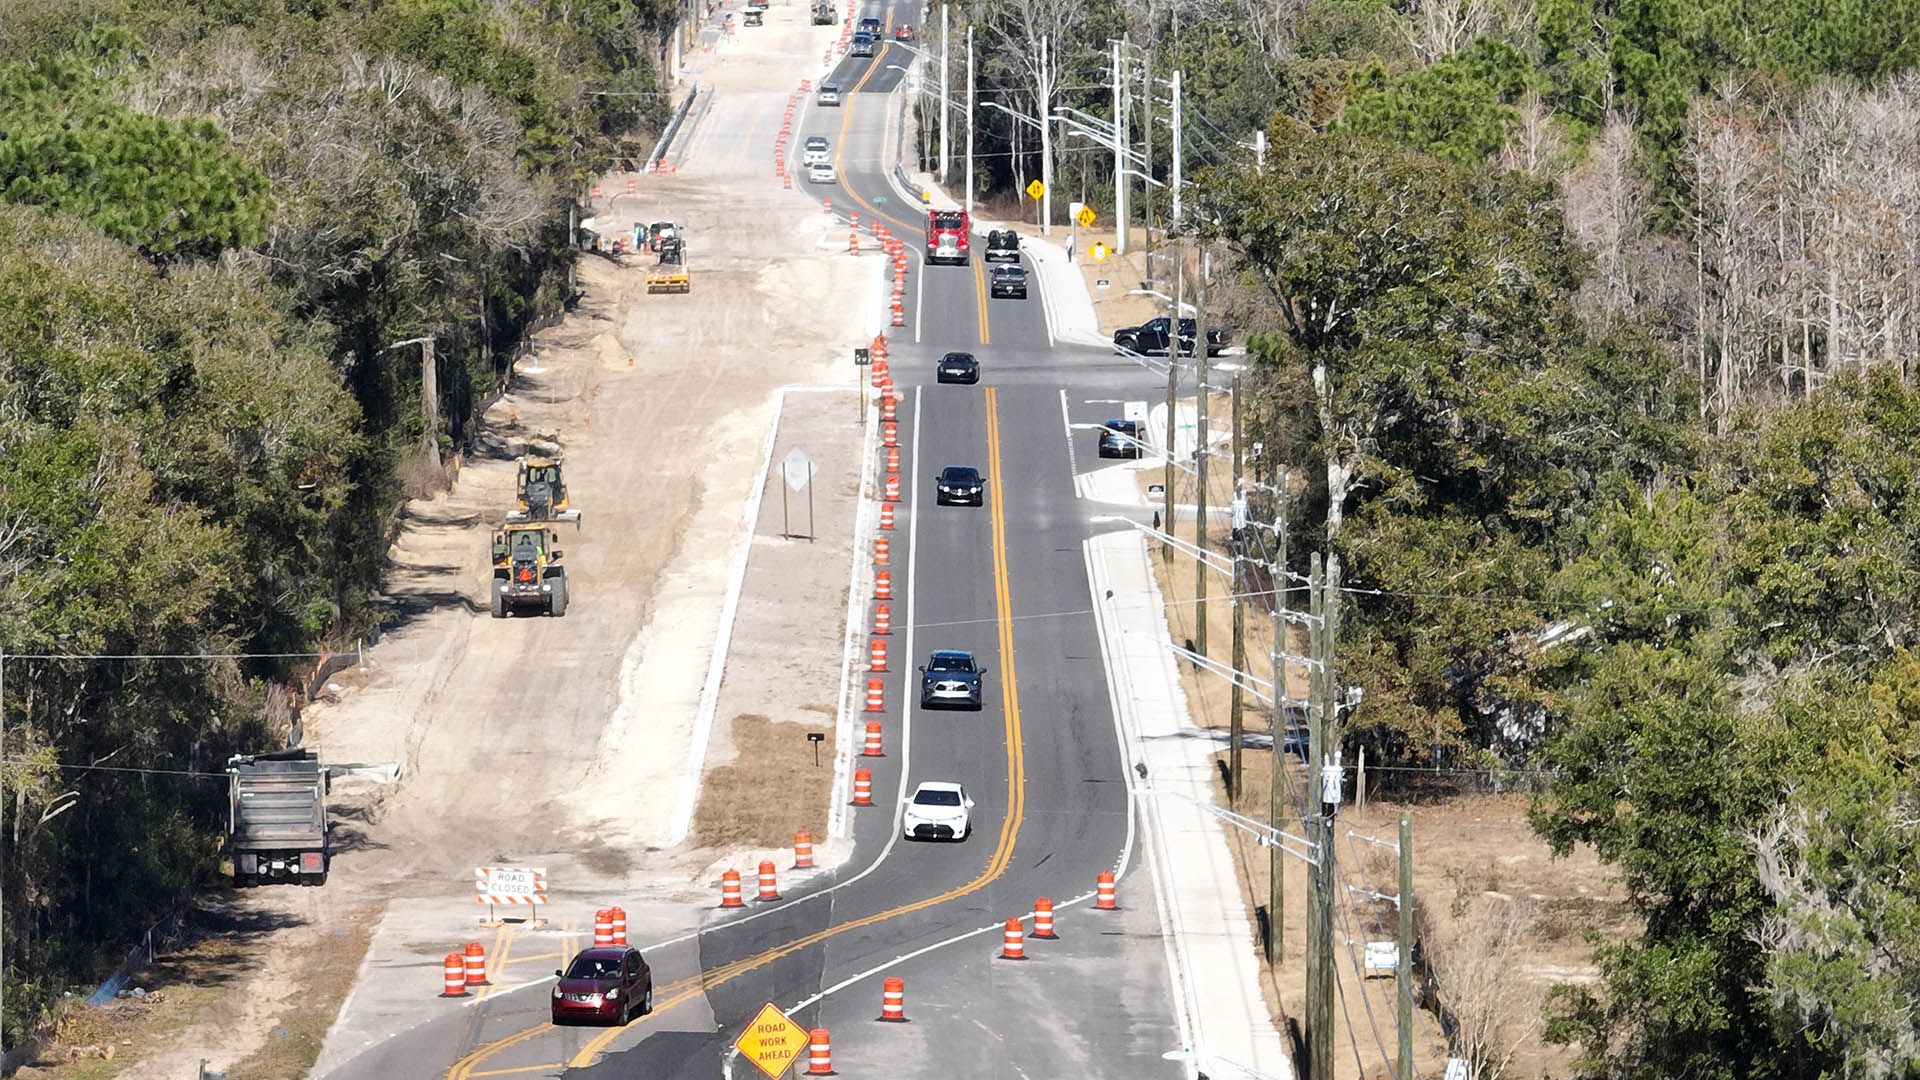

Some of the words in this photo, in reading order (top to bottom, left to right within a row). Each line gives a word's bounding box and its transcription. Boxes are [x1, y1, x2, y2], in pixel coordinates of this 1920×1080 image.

[498, 873, 525, 882] ROAD
[491, 883, 529, 894] CLOSED
[757, 1022, 786, 1034] ROAD
[759, 1037, 788, 1047] WORK
[759, 1049, 791, 1061] AHEAD
